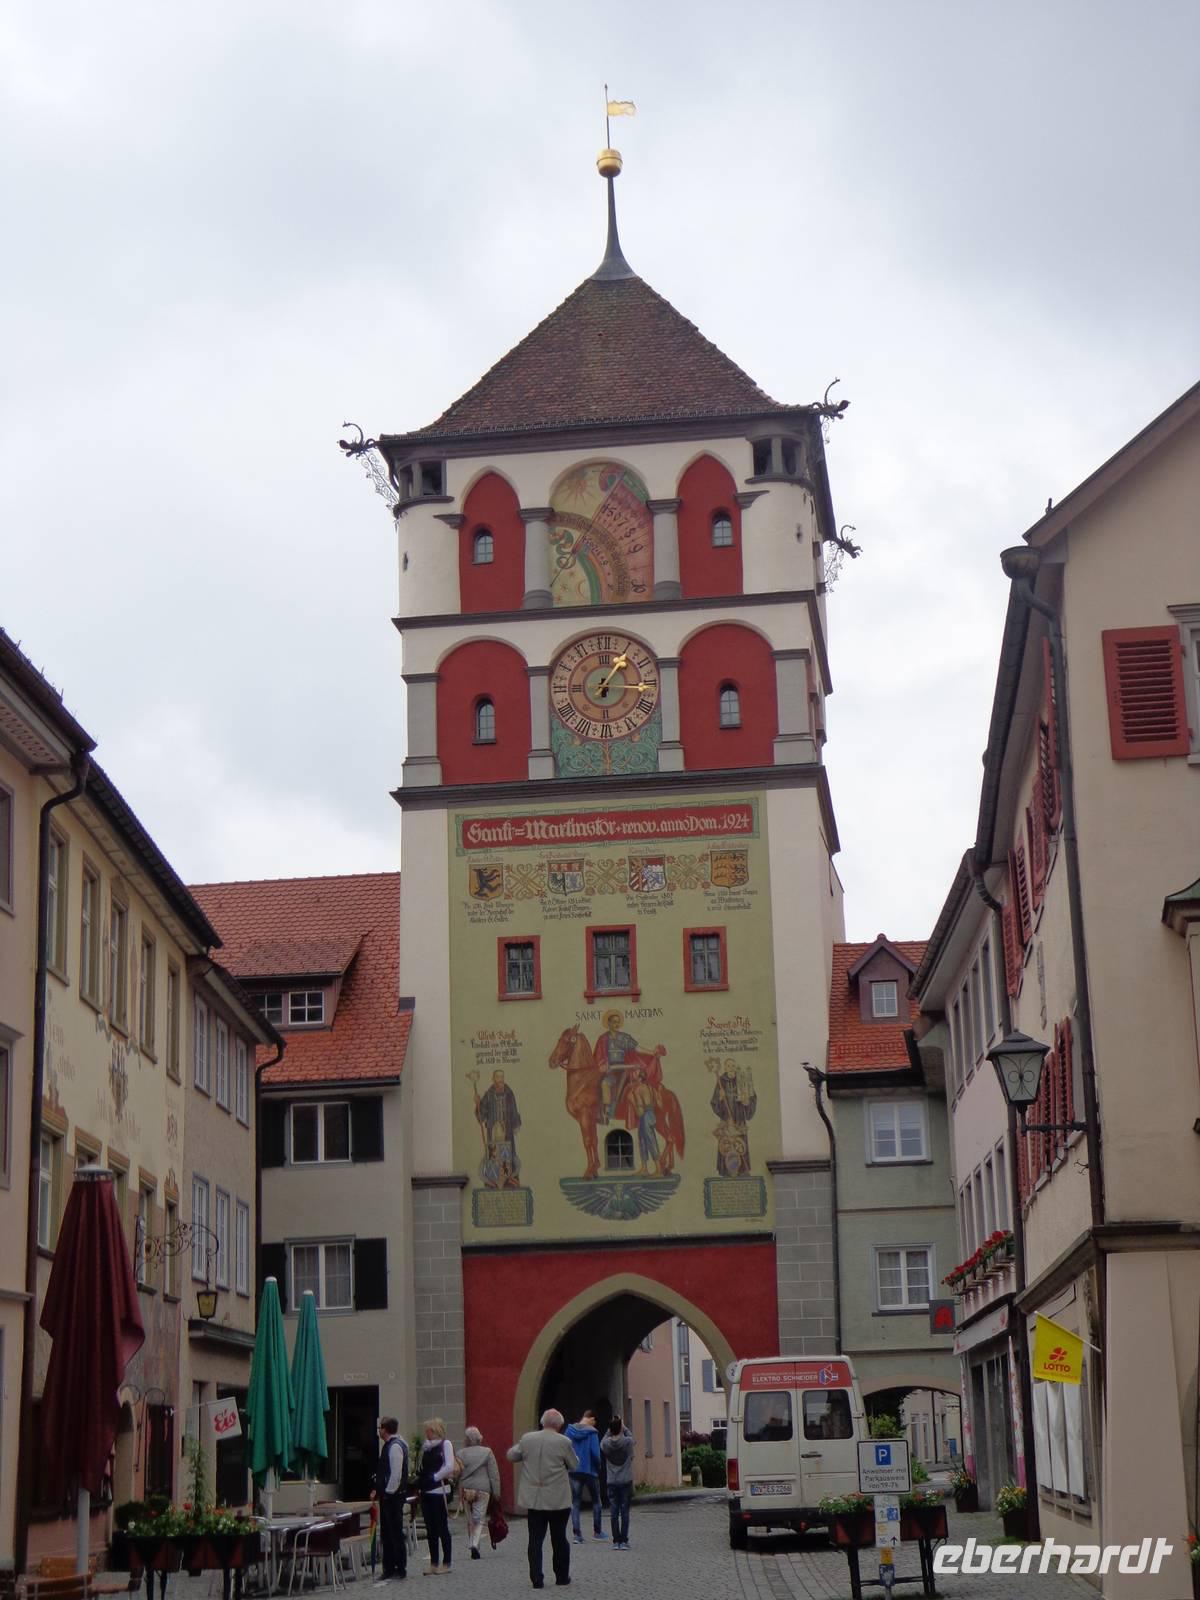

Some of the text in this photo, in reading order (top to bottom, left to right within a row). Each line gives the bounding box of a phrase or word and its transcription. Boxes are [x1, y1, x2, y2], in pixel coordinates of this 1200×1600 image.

[720, 813, 750, 831] 1924
[1043, 1362, 1071, 1372] LOTTO
[752, 1375, 780, 1383] ELEKTRO
[784, 1374, 817, 1382] SCHNEIDER
[878, 1449, 888, 1462] P
